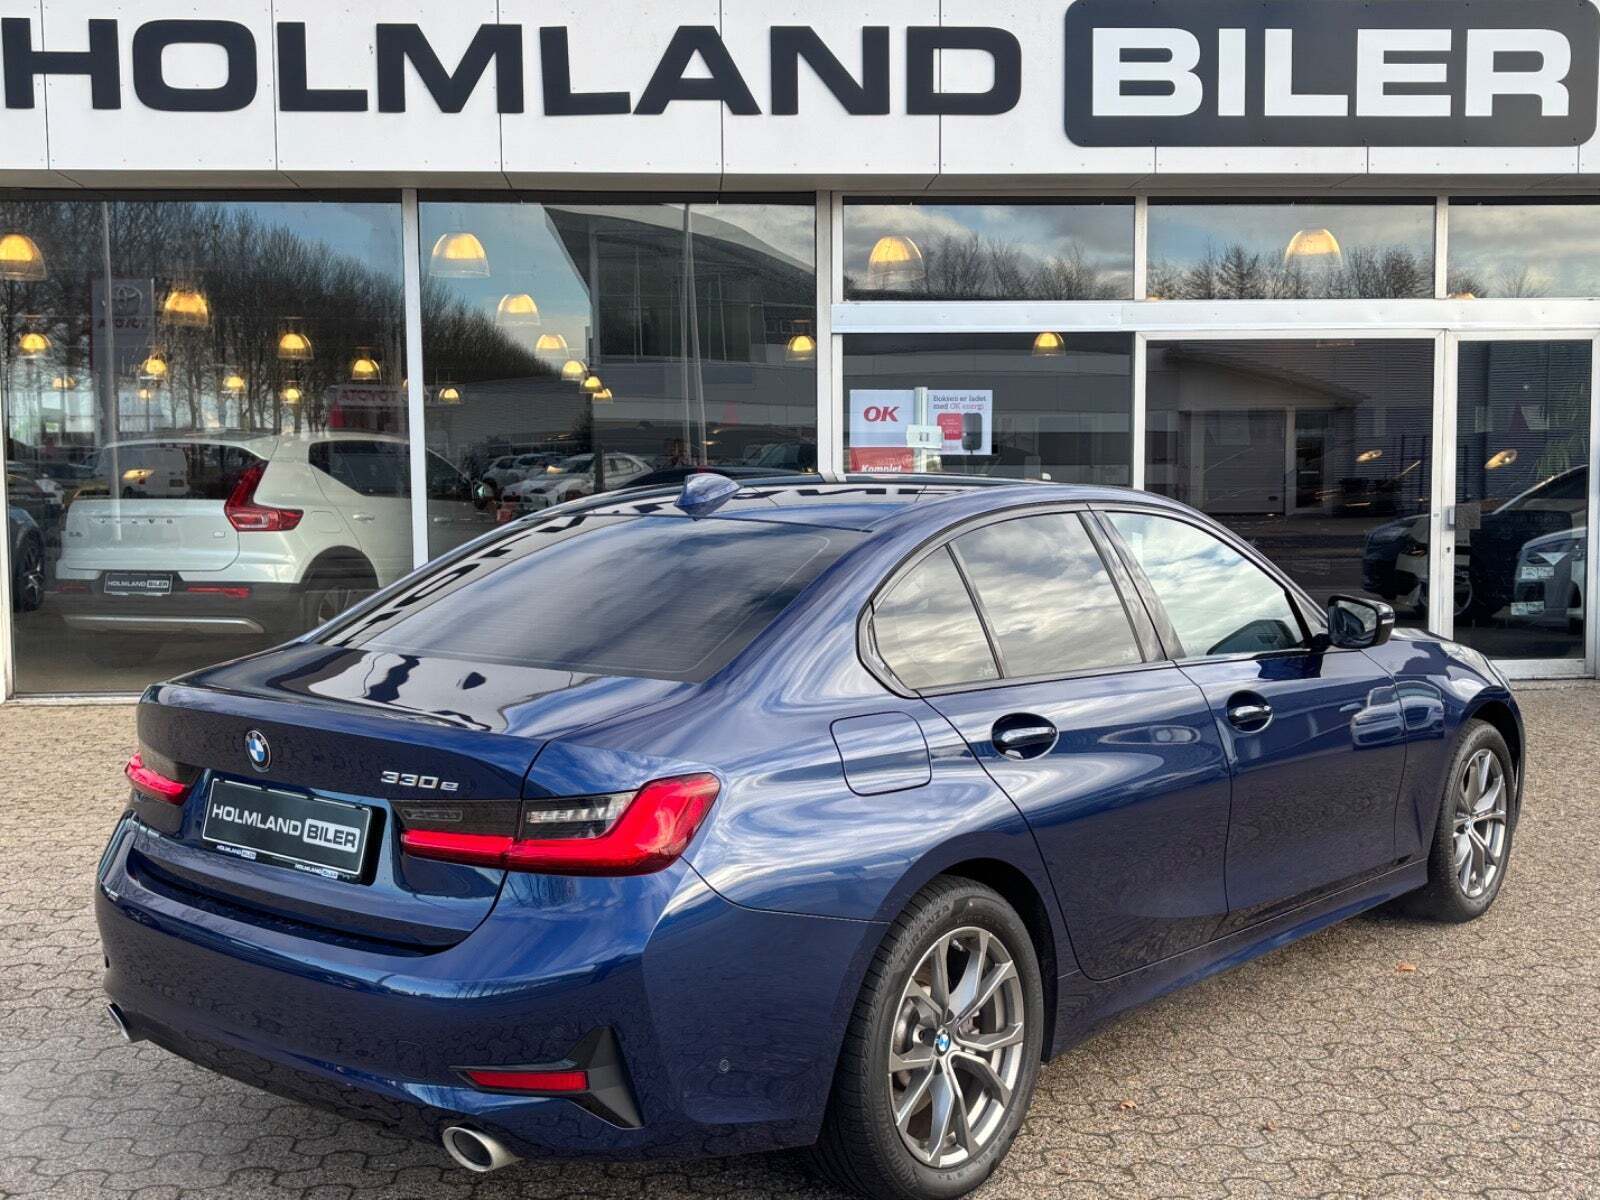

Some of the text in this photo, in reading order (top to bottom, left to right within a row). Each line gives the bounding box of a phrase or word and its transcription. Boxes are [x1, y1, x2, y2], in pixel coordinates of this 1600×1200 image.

[1, 17, 1572, 117] HOLMLAND BILER
[863, 406, 900, 422] OK
[381, 771, 459, 792] 330e
[212, 804, 358, 849] HOLMLAND BILER
